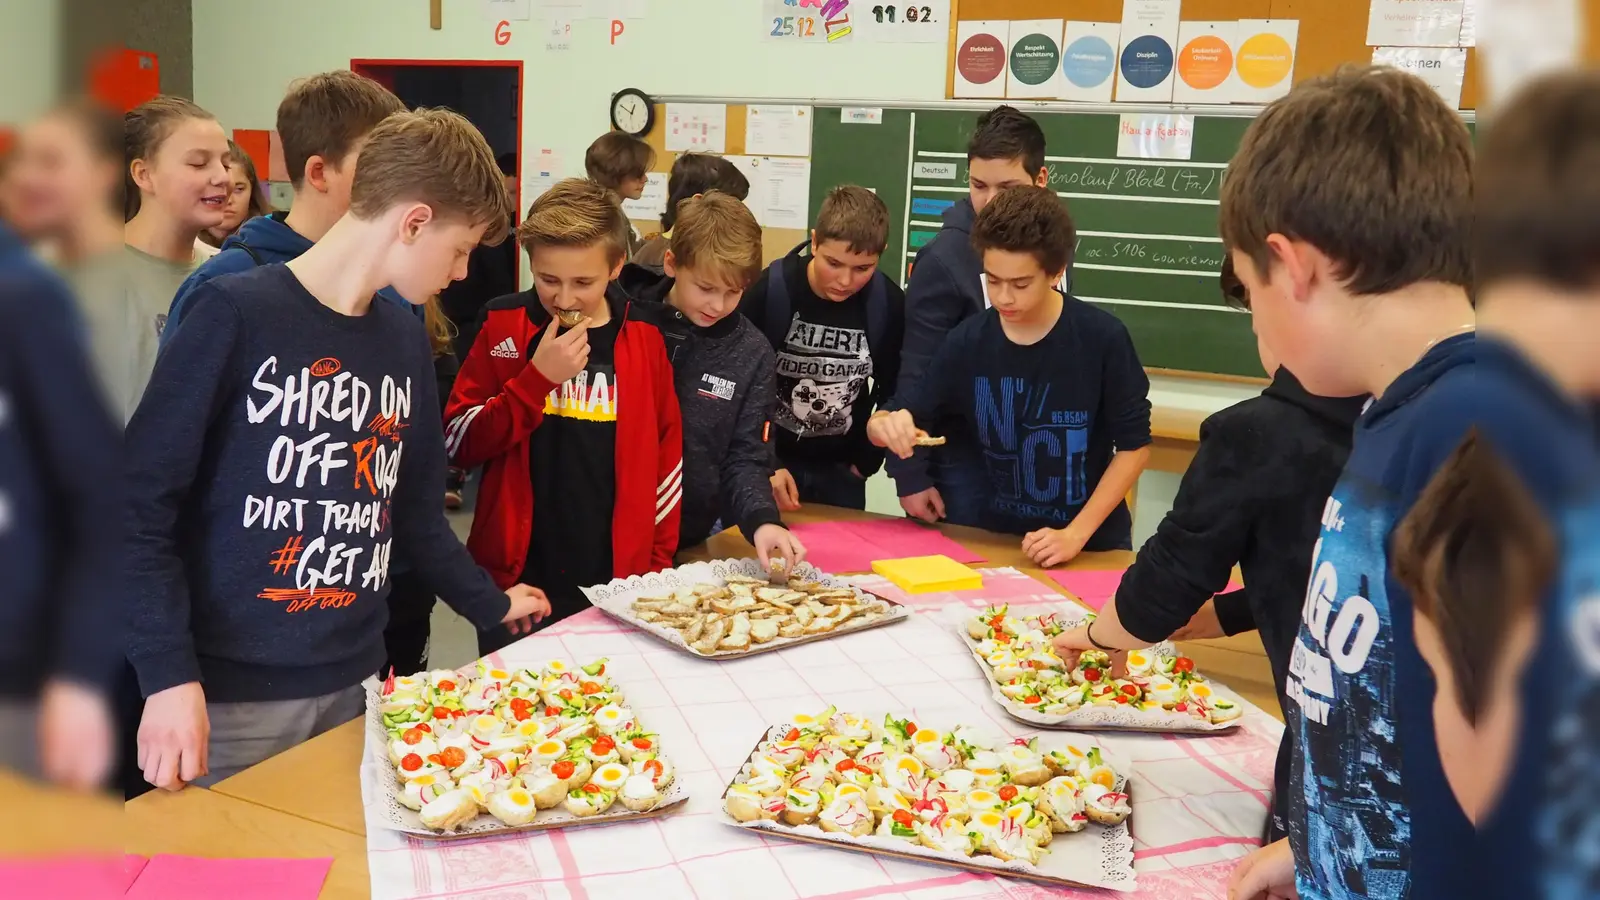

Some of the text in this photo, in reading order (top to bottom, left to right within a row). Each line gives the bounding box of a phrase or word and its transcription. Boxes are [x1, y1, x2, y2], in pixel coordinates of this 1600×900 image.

[872, 5, 937, 23] 11.02.
[494, 20, 512, 46] G
[610, 20, 624, 45] P
[1015, 51, 1054, 59] Wertschätzung
[921, 166, 949, 174] Deutsch
[1123, 167, 1166, 188] Block
[789, 323, 865, 352] ALERT
[490, 349, 520, 359] adidas
[776, 358, 819, 375] VIDEO
[246, 356, 412, 432] SHRED ON
[267, 433, 348, 488] OFF
[243, 495, 309, 532] DIRT
[316, 499, 381, 538] TRACK
[286, 592, 357, 614] OFF GRID
[1302, 537, 1380, 674] GO
